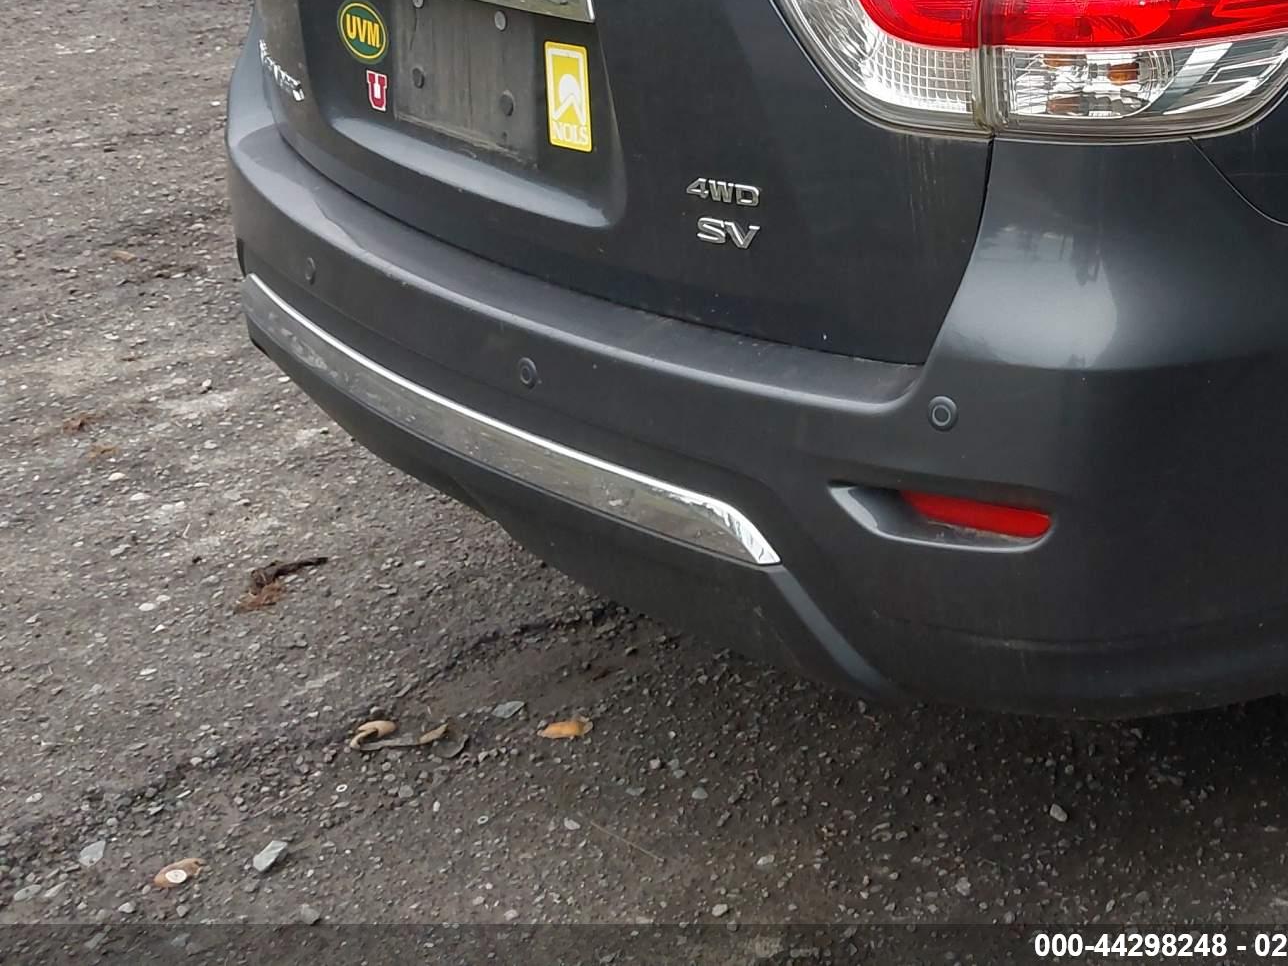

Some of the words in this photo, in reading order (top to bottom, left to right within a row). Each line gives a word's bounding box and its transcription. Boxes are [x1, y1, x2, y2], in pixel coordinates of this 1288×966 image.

[346, 13, 380, 48] UVM
[366, 69, 387, 112] U
[552, 120, 589, 145] NOLS
[686, 177, 760, 207] 4WD
[697, 217, 761, 249] SV
